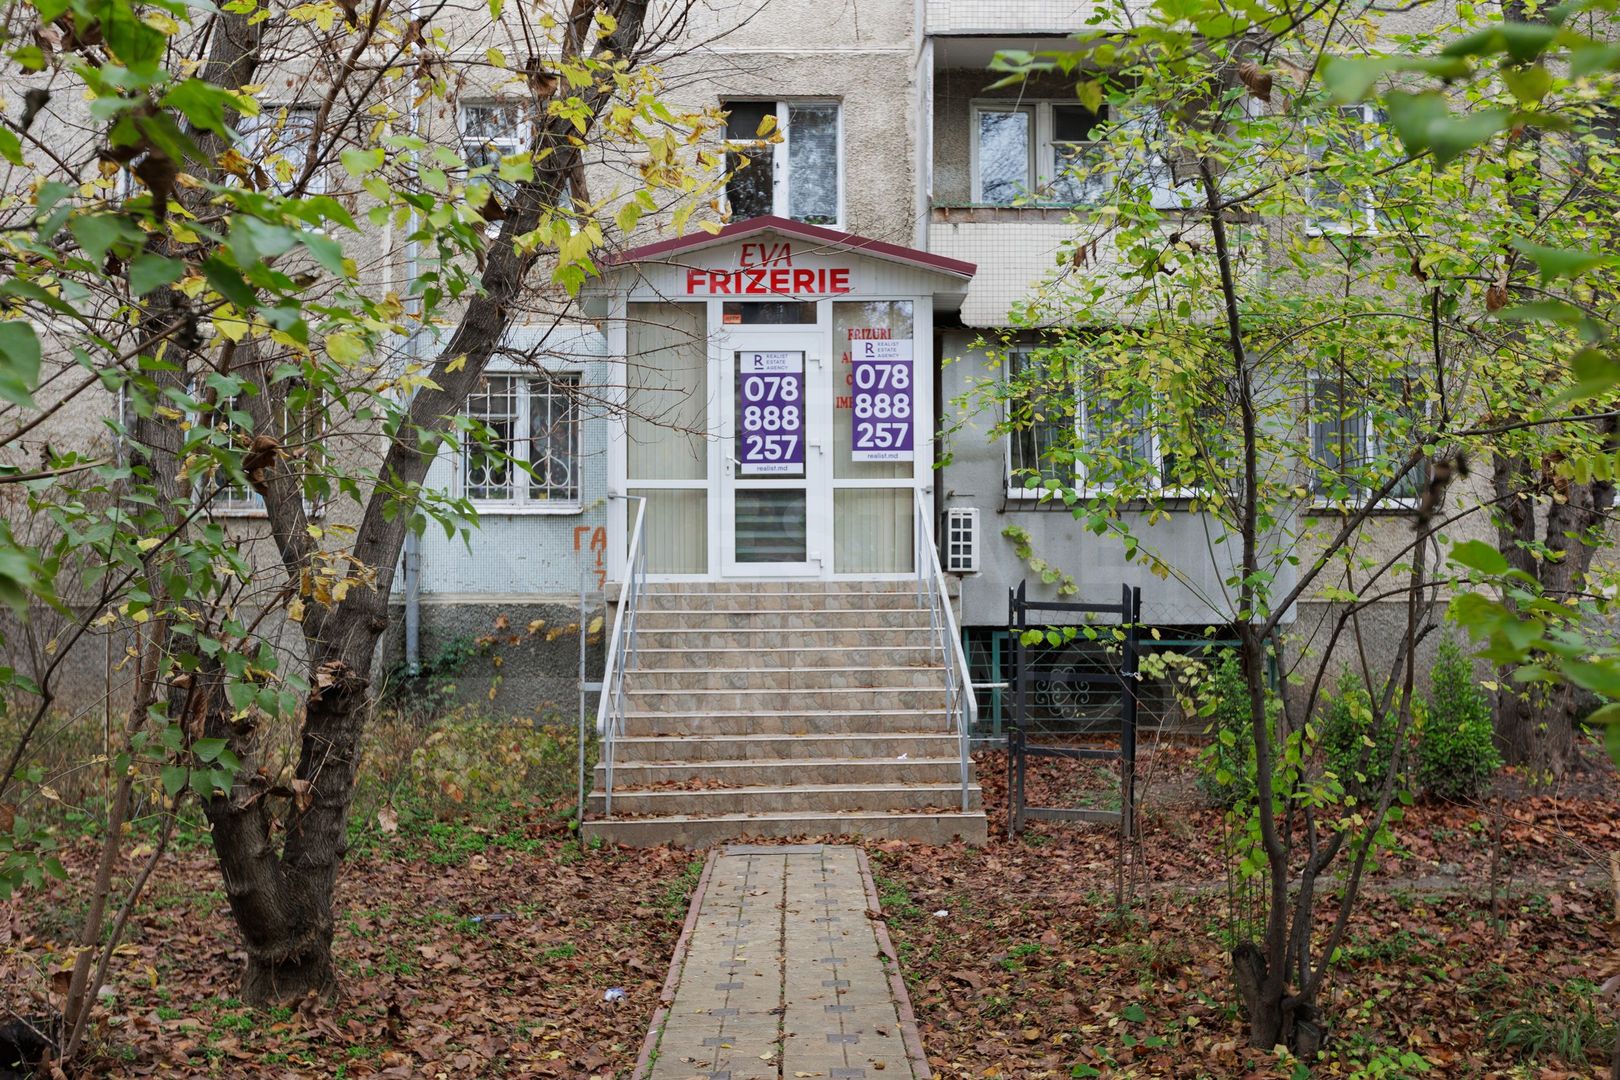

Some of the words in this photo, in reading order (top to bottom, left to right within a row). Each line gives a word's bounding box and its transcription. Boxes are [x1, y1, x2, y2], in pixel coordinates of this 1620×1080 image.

[740, 243, 792, 267] EVA
[687, 269, 849, 293] FRIZERIE
[848, 328, 892, 340] FRIZURI
[744, 376, 798, 401] 078
[855, 364, 910, 389] 078
[744, 405, 800, 430] 888
[855, 393, 910, 418] 888
[746, 434, 798, 460] 257
[857, 422, 908, 447] 257
[867, 452, 899, 460] realist.md
